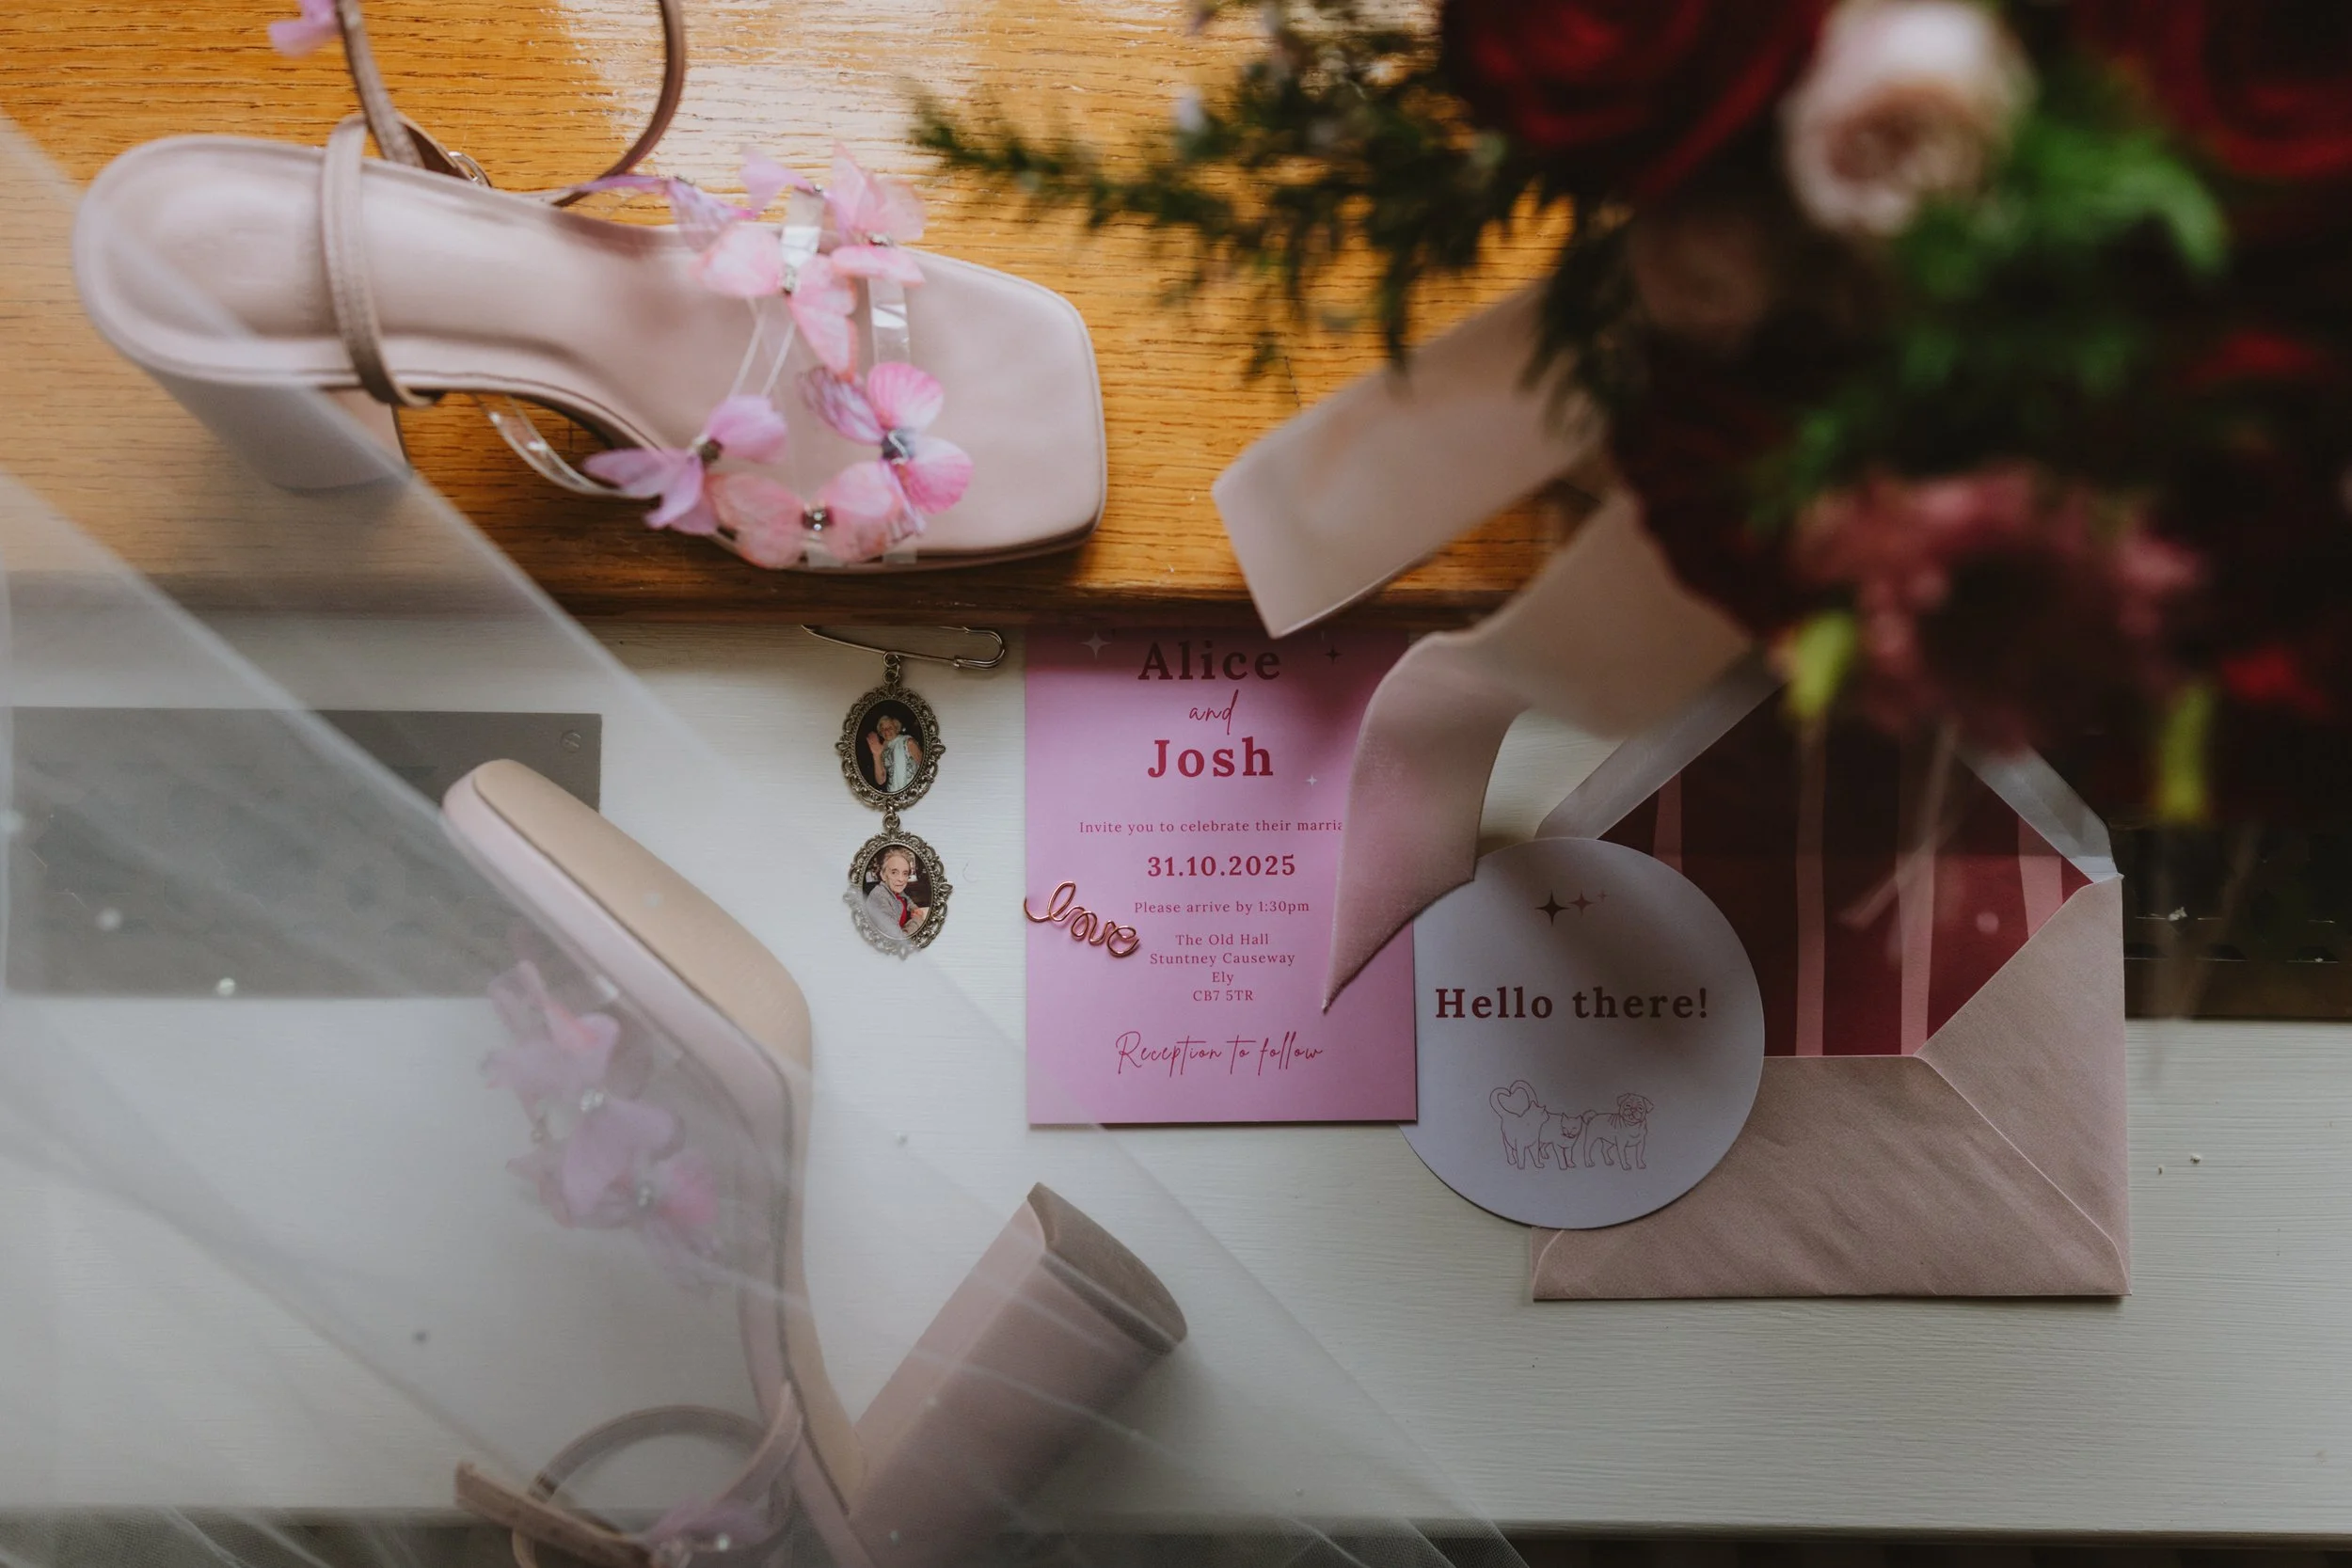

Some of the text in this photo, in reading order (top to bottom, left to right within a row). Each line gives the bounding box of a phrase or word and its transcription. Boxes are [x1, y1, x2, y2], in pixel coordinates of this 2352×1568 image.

[1137, 640, 1281, 681] Alice
[1188, 689, 1239, 736] and
[1147, 736, 1274, 778] Josh
[1079, 819, 1343, 836] Invite you to celebrate their marria
[1147, 855, 1295, 878] 31.10.2025
[1024, 880, 1139, 958] love
[1135, 900, 1310, 916] Please arrive by 1:30pm
[1175, 933, 1270, 945] The Old Hall
[1150, 952, 1295, 968] Stuntney Causeway
[1212, 970, 1234, 986] Ely
[1192, 989, 1254, 1003] CB7 5TR
[1436, 986, 1708, 1019] Hello there!
[1115, 1030, 1324, 1079] Reception to follow
